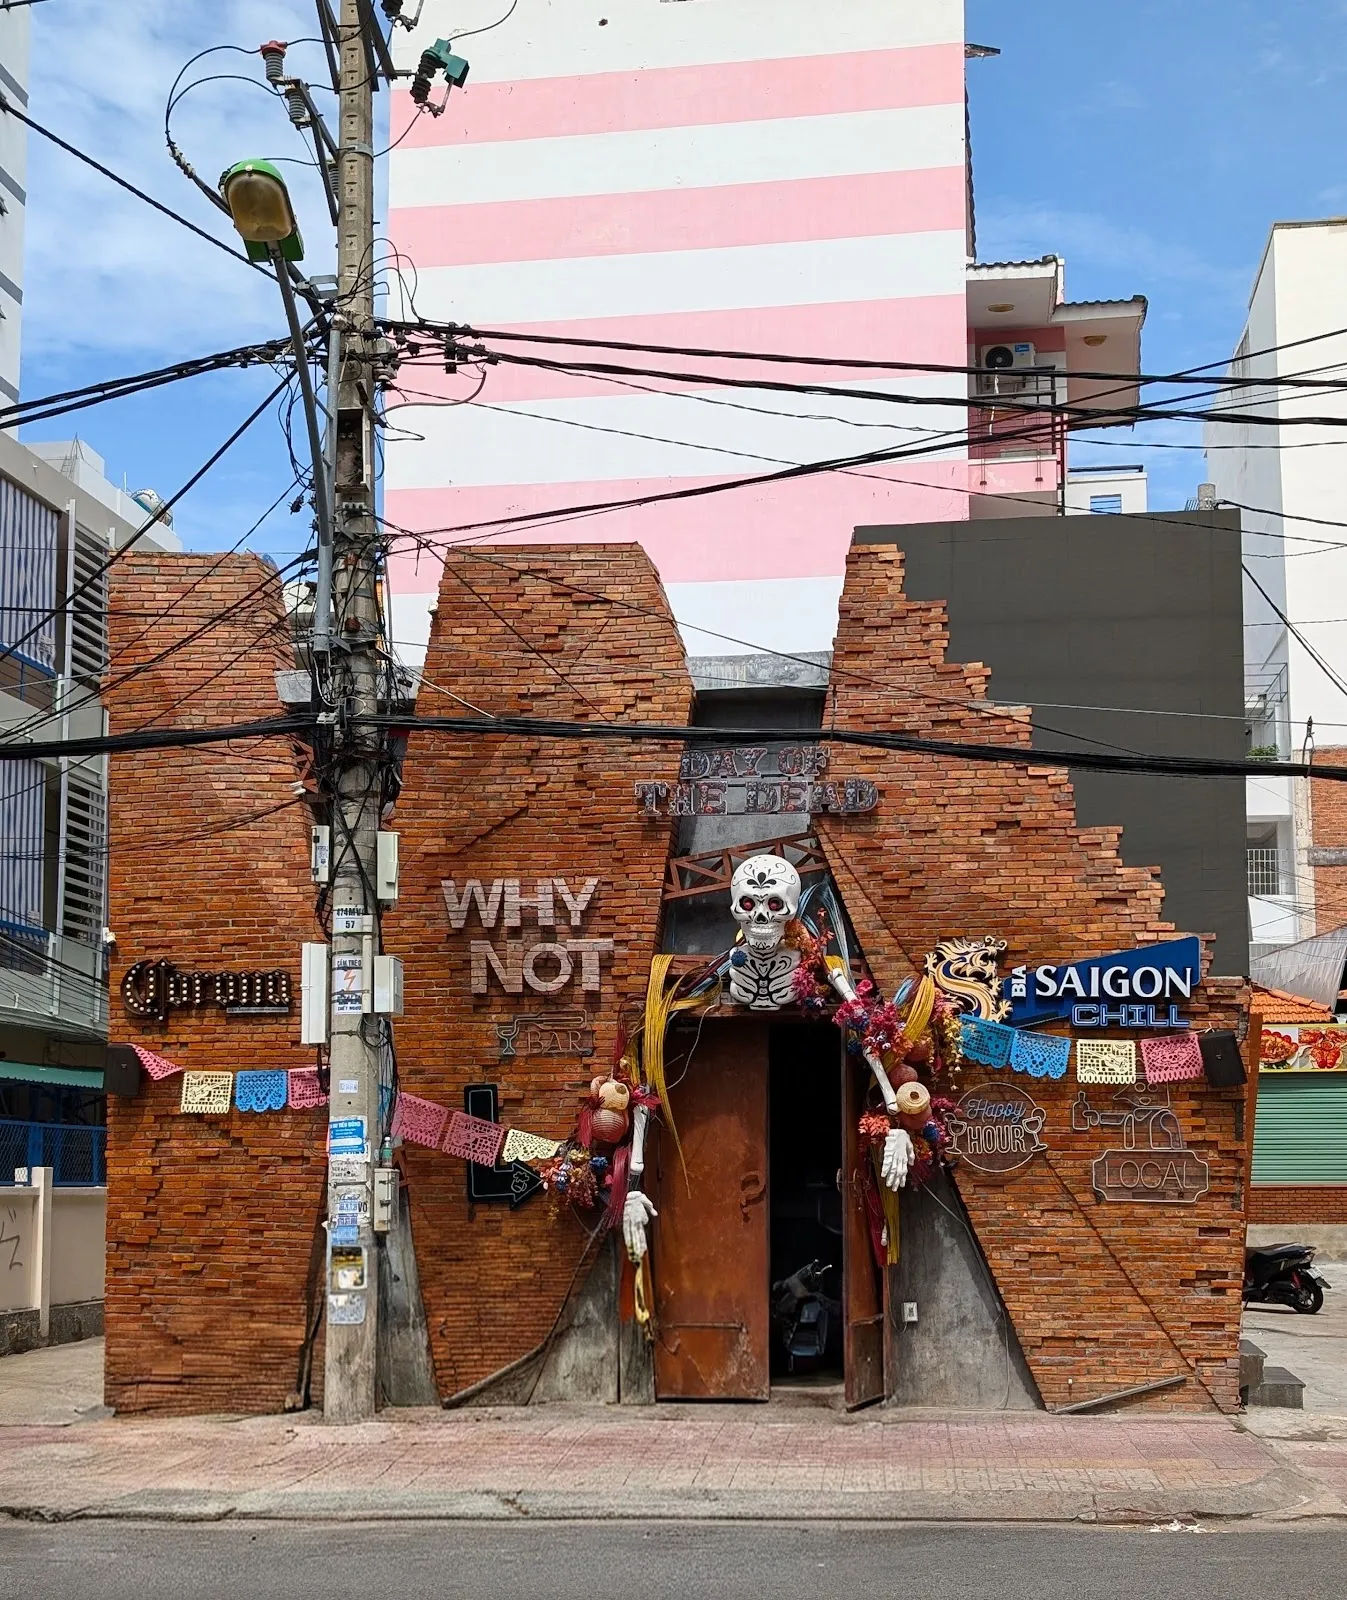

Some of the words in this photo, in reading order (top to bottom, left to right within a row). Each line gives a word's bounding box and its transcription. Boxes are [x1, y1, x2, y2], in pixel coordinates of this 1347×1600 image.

[680, 747, 767, 780] DAY
[777, 746, 830, 777] OF
[635, 781, 727, 816] THE
[745, 779, 878, 815] DEAD
[441, 877, 599, 928] WHY
[345, 920, 355, 928] 57
[470, 938, 614, 993] NOT
[1011, 964, 1027, 997] BIA
[1035, 965, 1191, 998] SAIGON
[120, 957, 292, 1021] Corona
[1071, 1004, 1190, 1027] CHILL
[527, 1030, 582, 1052] BAR
[967, 1099, 1026, 1123] Happy
[967, 1125, 1026, 1153] HOUR
[1104, 1158, 1199, 1189] LOCAL
